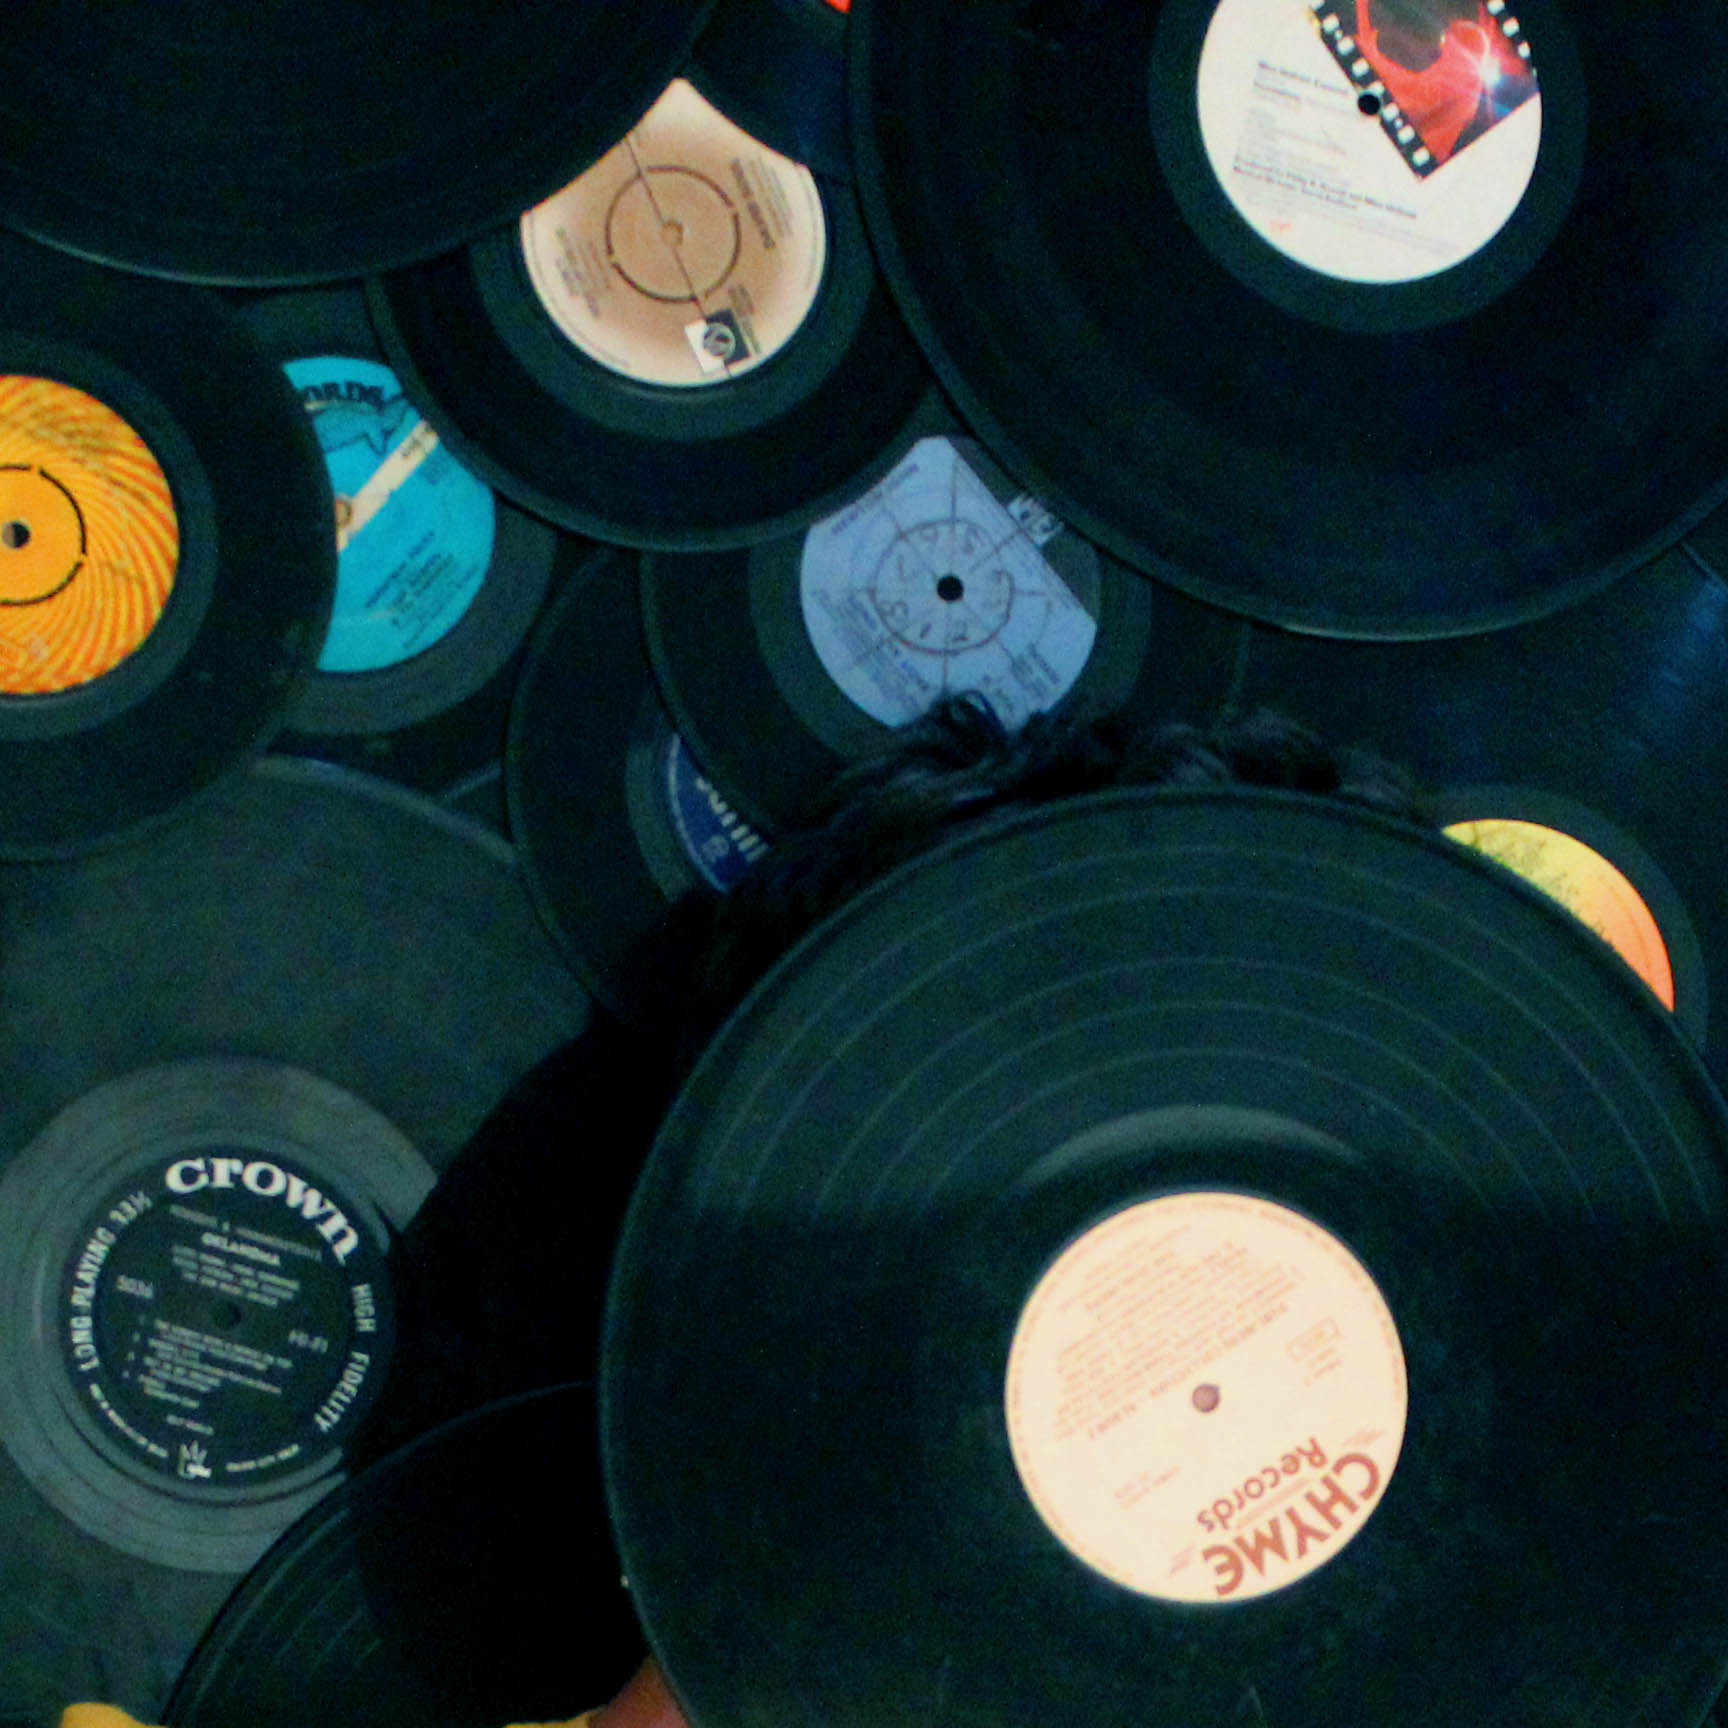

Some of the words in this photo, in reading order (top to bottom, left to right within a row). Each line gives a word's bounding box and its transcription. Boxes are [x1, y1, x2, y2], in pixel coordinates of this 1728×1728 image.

[71, 1227, 116, 1308] PLAYING
[351, 1282, 377, 1332] HIGH
[70, 1314, 100, 1372] LONG
[314, 1351, 370, 1433] FIDELITY
[1198, 1437, 1328, 1532] Records
[1202, 1453, 1380, 1595] CHYME
